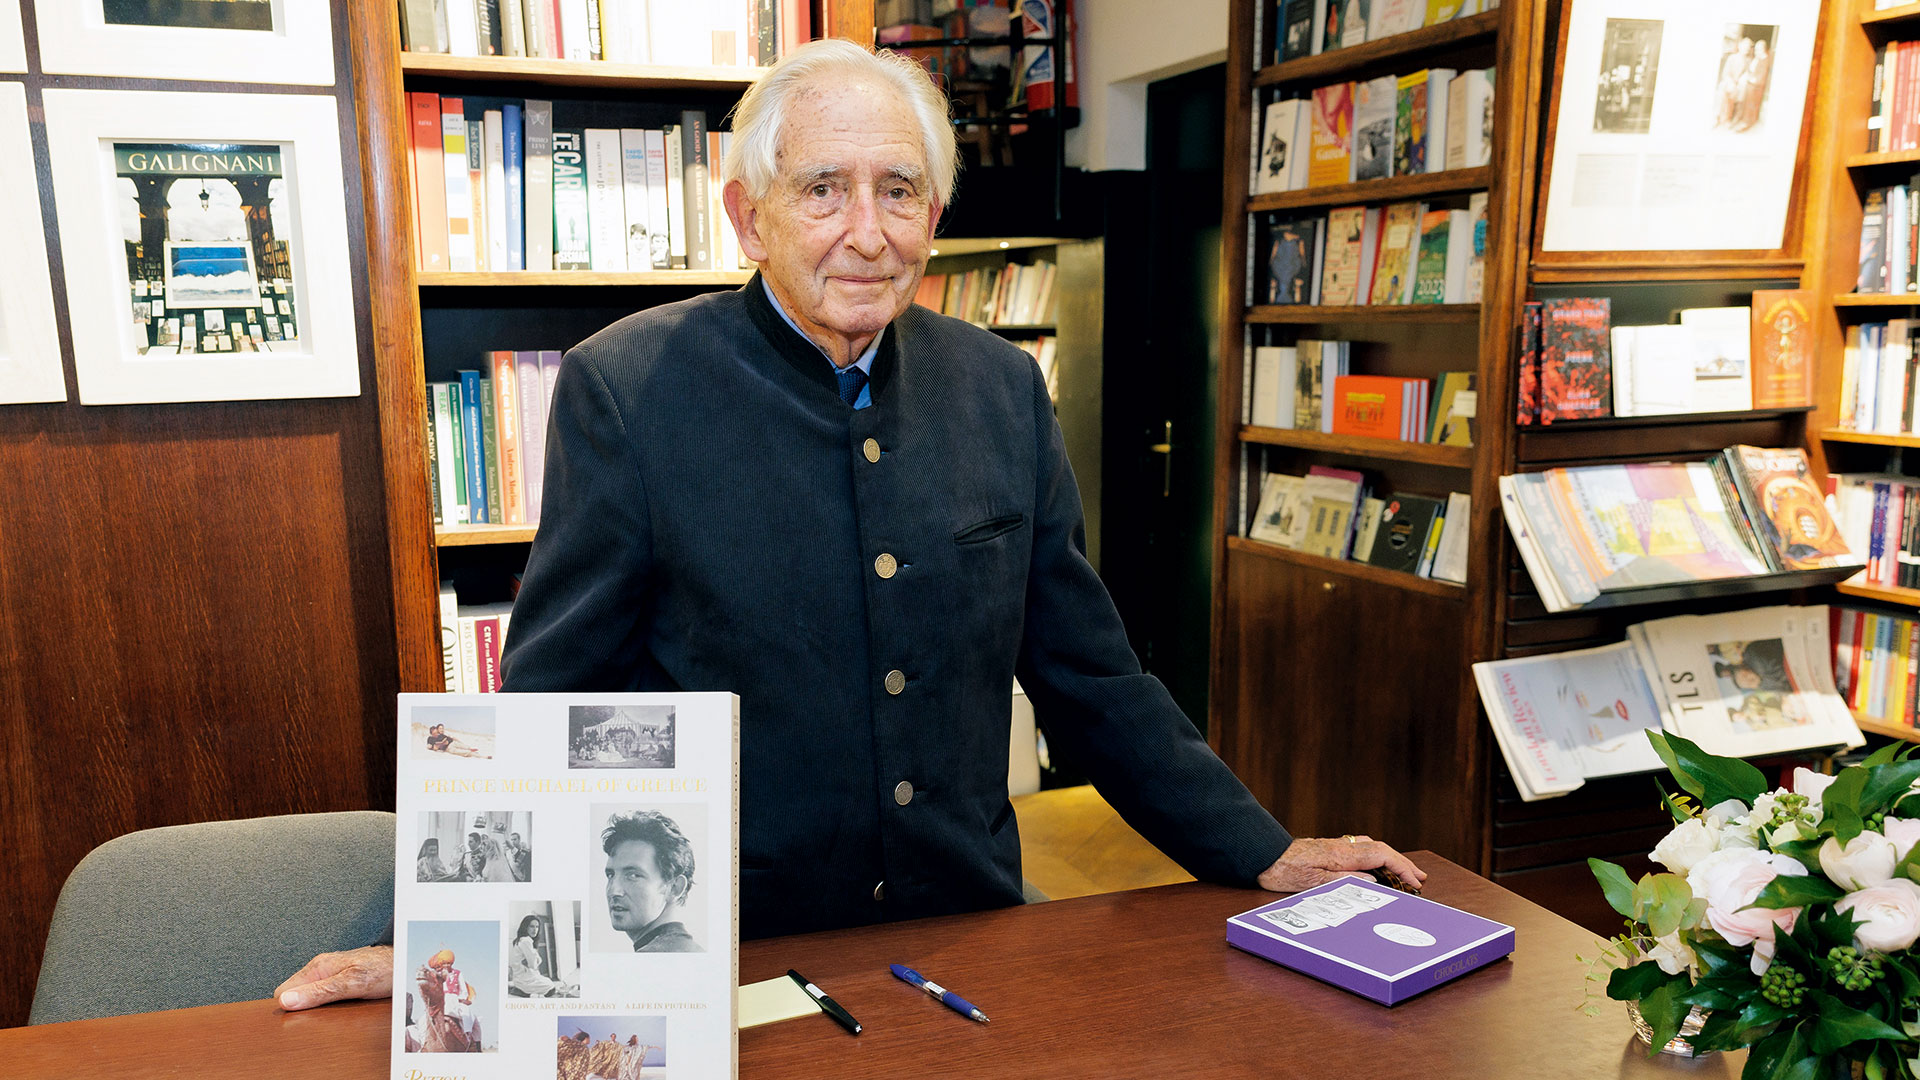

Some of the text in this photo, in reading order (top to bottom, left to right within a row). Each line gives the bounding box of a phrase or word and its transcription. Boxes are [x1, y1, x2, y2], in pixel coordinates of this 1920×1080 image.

[552, 132, 573, 151] LE
[694, 130, 703, 153] GOOD
[129, 153, 275, 173] GALIGNANI
[545, 366, 553, 382] VIET
[520, 366, 531, 442] VIET THANH NGUYEN
[506, 448, 517, 508] Andrew Motion
[464, 622, 473, 639] IRIS
[482, 625, 492, 644] CRY
[464, 641, 474, 673] ORIGO
[486, 657, 496, 693] KALAHAR
[1670, 671, 1703, 715] TLS
[1501, 671, 1558, 782] London Review
[423, 777, 710, 794] PRINCE MICHAEL OF GREECE
[1434, 953, 1479, 981] CHOCOLATS
[560, 1002, 577, 1010] AND
[578, 1002, 617, 1010] FANTASY
[625, 1002, 631, 1010] A
[632, 1002, 652, 1010] LIFE
[654, 1002, 663, 1010] IN
[664, 1002, 709, 1010] PICTURES
